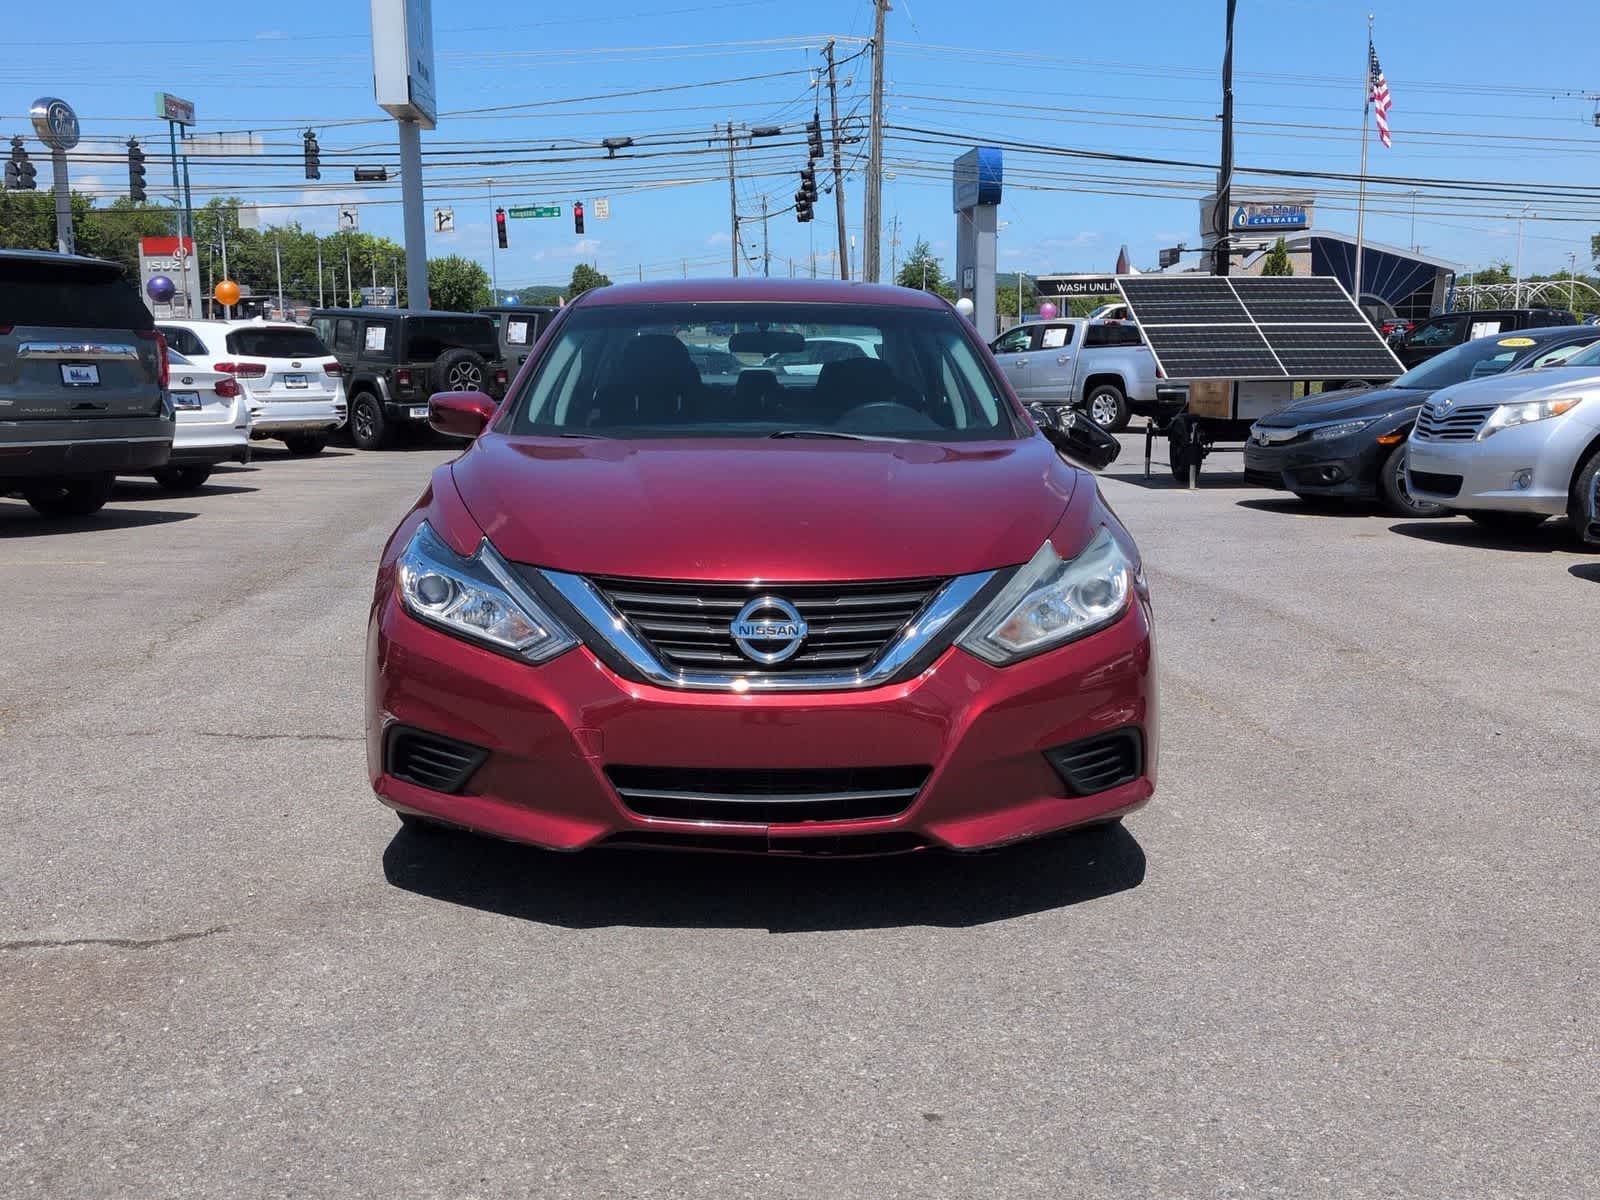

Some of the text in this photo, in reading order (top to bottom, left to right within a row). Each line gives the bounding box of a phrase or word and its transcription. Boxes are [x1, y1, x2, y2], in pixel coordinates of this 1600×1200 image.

[1254, 216, 1299, 224] CARWASH
[147, 261, 191, 271] ISUZU
[1056, 283, 1087, 292] WASH
[739, 625, 799, 636] NISSAN
